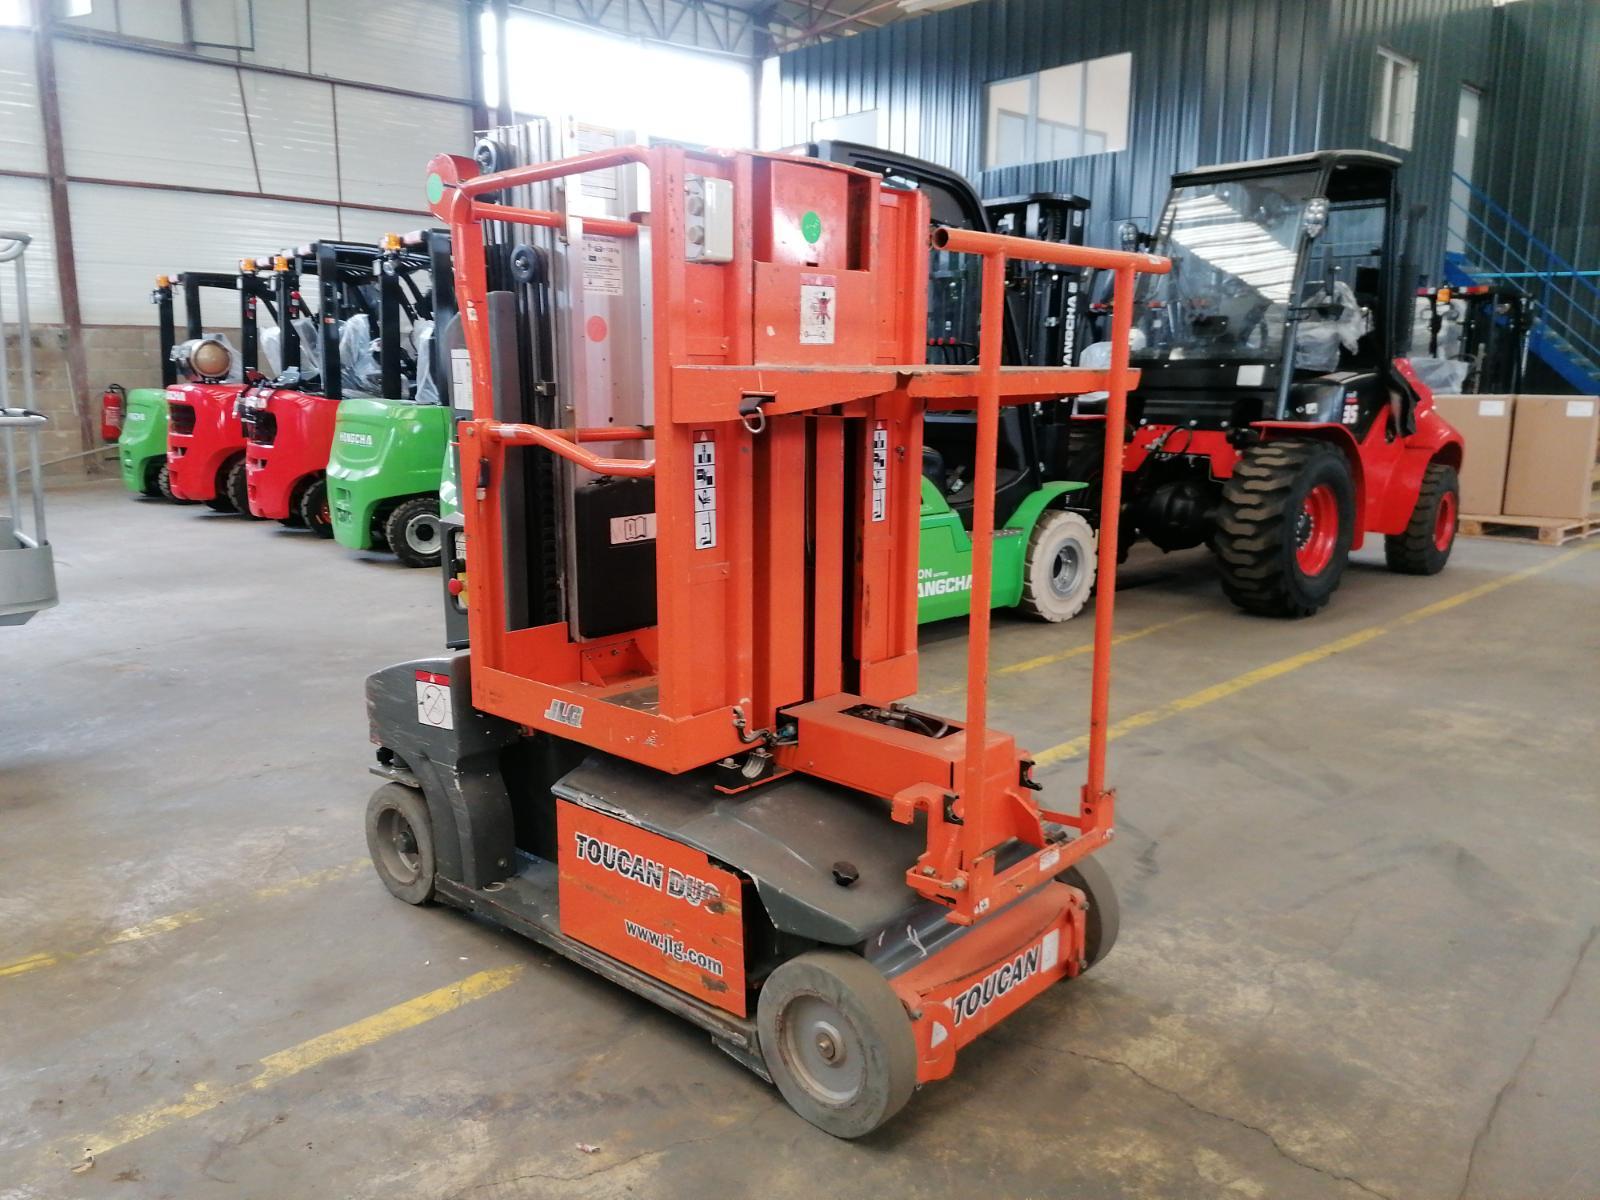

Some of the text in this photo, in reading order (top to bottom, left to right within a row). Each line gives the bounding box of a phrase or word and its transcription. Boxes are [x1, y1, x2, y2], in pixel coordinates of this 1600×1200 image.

[544, 699, 584, 728] JLG
[575, 832, 664, 891] TOUCAN
[624, 919, 724, 977] www.jlg.com
[953, 944, 1041, 1027] TOUCAN
